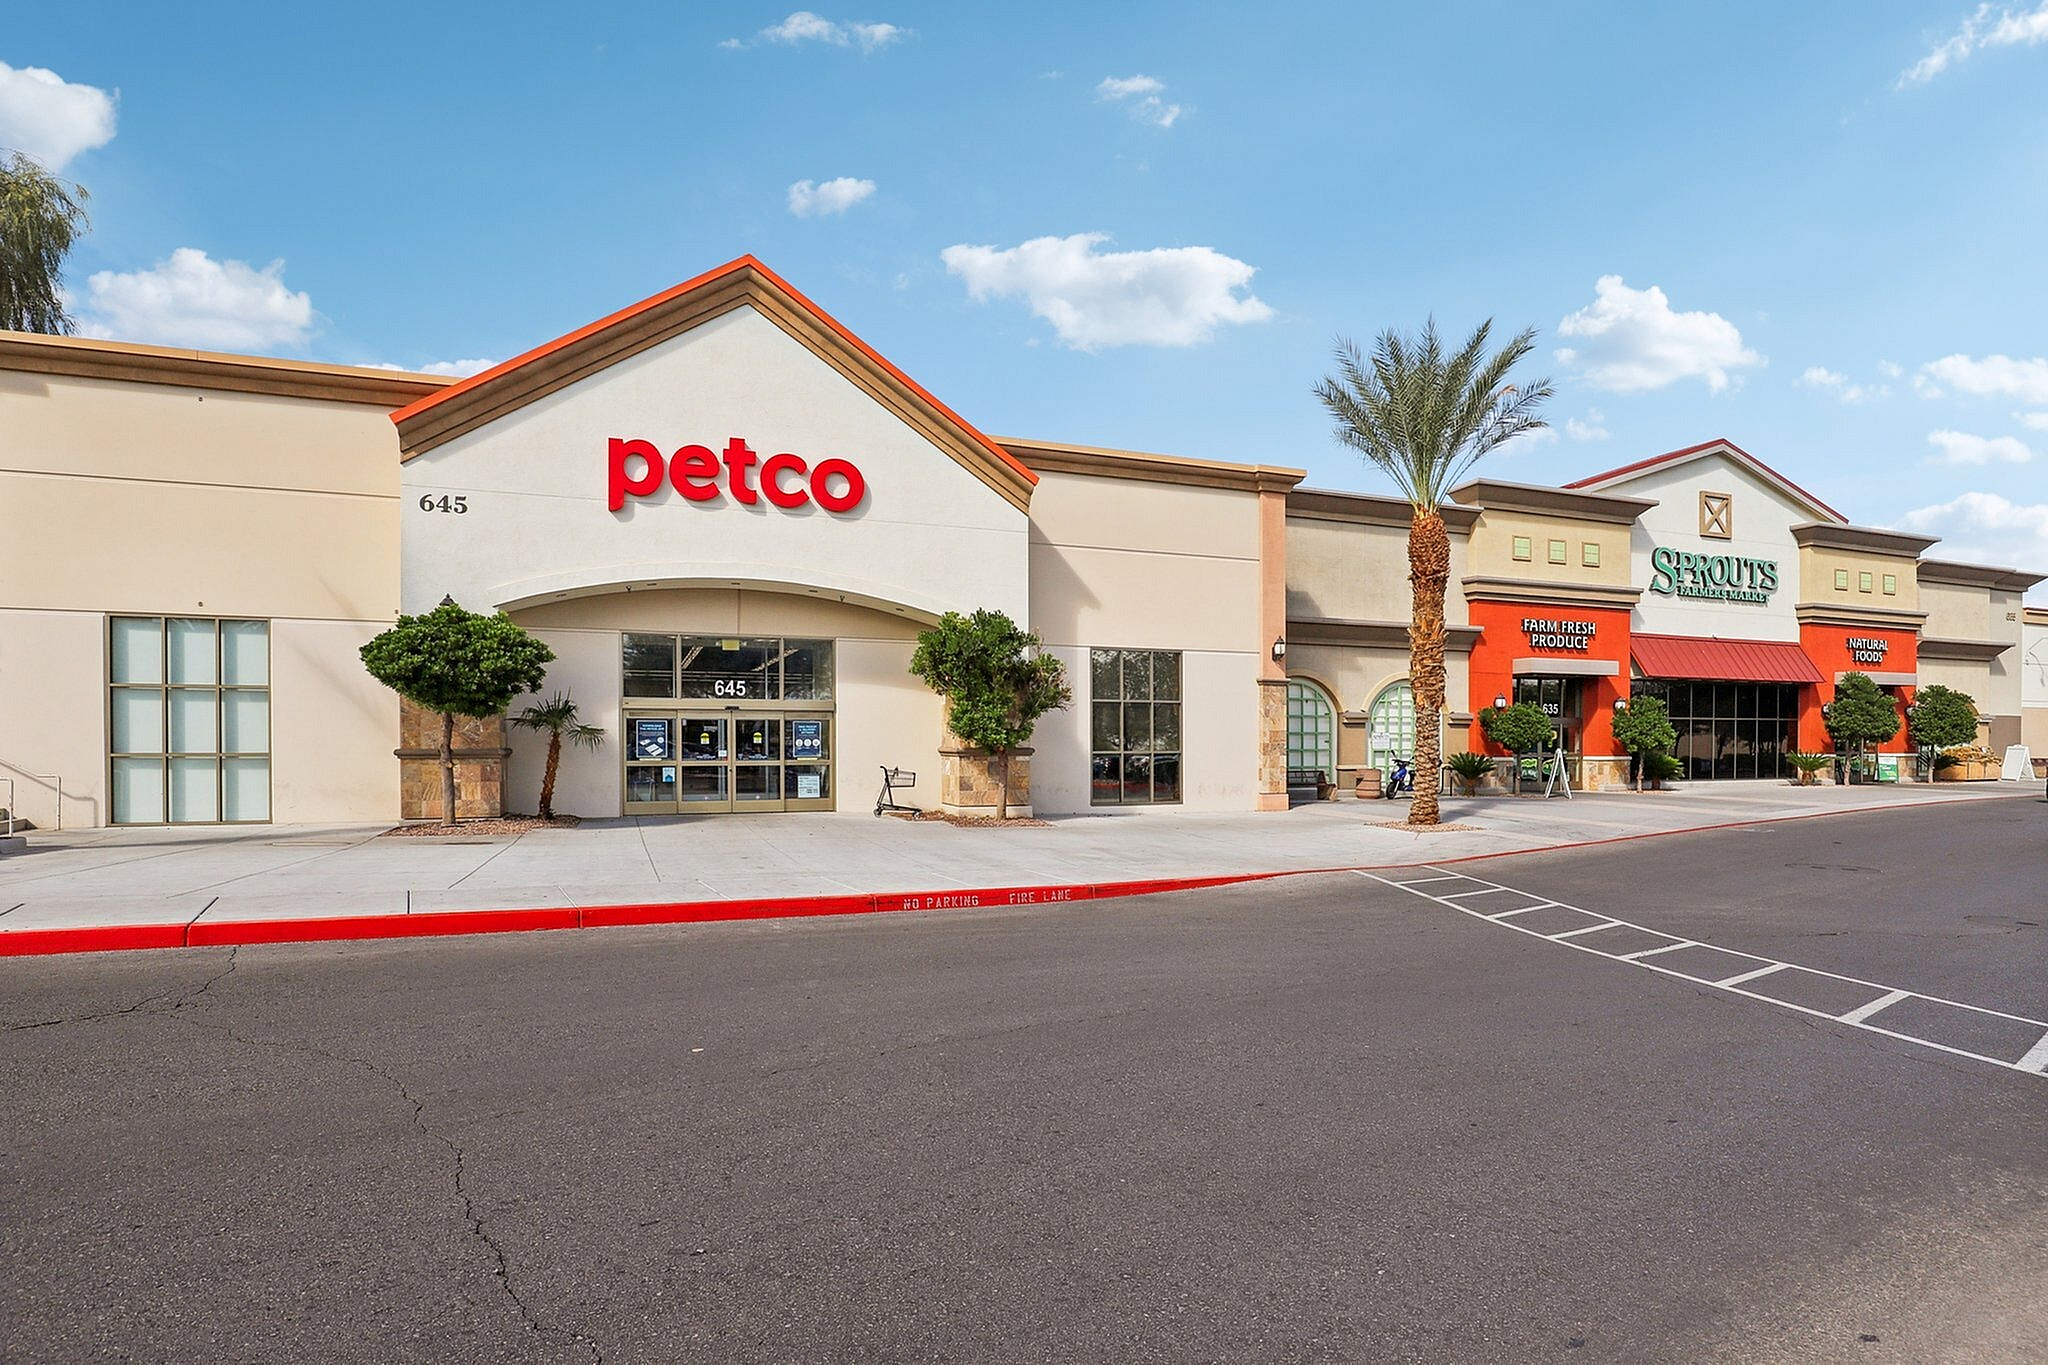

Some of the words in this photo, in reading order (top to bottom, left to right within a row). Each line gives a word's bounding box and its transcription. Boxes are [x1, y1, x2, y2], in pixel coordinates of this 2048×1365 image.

[608, 437, 865, 513] petco
[419, 493, 468, 514] 645
[1650, 546, 1779, 593] SPROUTS
[1679, 586, 1727, 599] FARMERS
[1523, 618, 1557, 633] FARM
[1561, 621, 1596, 634] FRESH
[1532, 633, 1588, 649] PRODUCE
[1849, 638, 1888, 651] NATURAL
[1855, 650, 1883, 662] FOODS
[714, 679, 746, 696] 645
[1542, 703, 1559, 715] 635
[903, 898, 920, 910] NO
[926, 895, 979, 908] PARKING
[1009, 891, 1036, 904] FIRE
[1042, 888, 1072, 901] LANE
